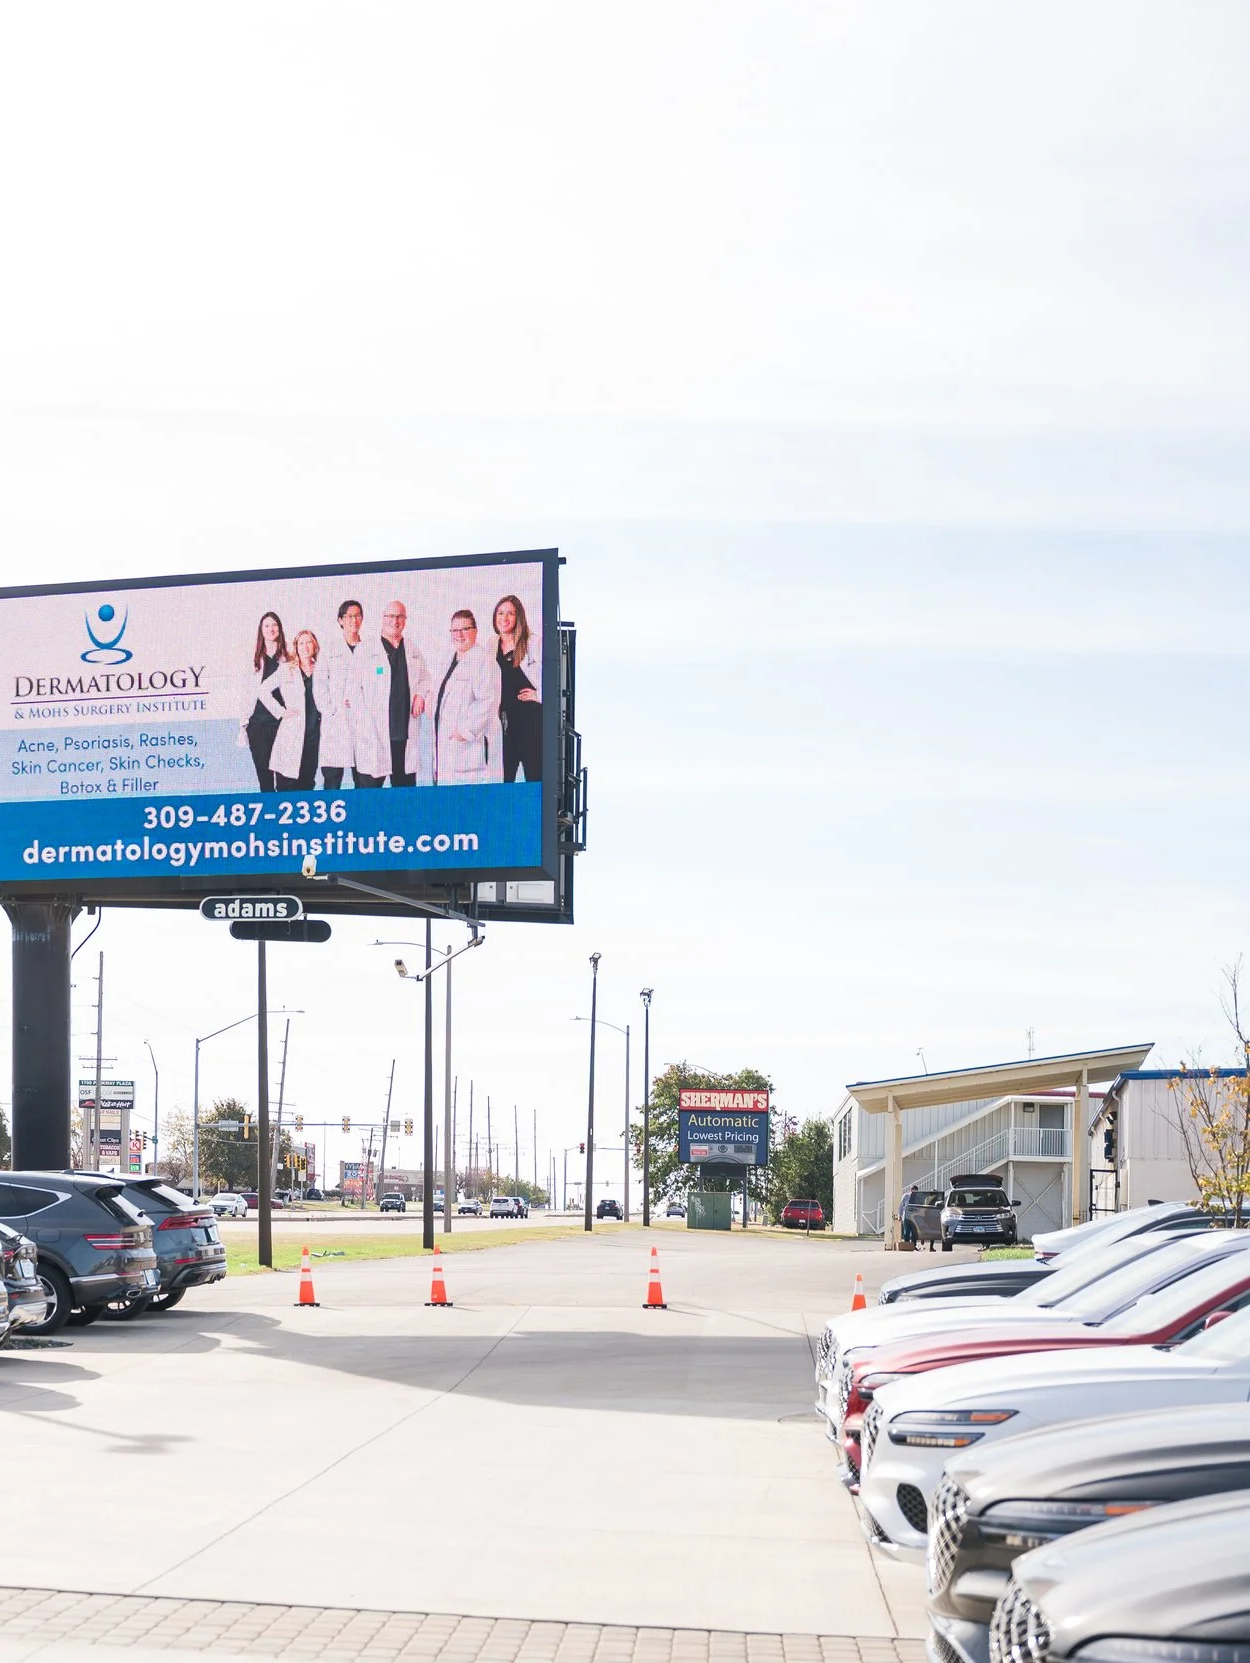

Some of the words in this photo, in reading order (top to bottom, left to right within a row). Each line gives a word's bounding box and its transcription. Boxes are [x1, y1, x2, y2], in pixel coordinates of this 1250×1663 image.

[14, 665, 207, 698] DERMATOLOGY
[14, 708, 25, 720] &
[28, 705, 70, 719] MOHS
[73, 702, 132, 717] SURGERY
[136, 699, 207, 714] INSTITUTE
[17, 739, 59, 755] Acne,
[64, 734, 134, 751] Psoriasis,
[139, 731, 198, 748] Rashes,
[11, 760, 42, 776] Skin
[46, 759, 105, 774] Cancer,
[109, 755, 141, 771] Skin
[145, 753, 206, 770] Checks,
[60, 780, 102, 795] Botox
[106, 778, 117, 793] &
[122, 777, 159, 792] Filler
[142, 799, 348, 829] 309-487-2336
[22, 830, 480, 867] dermatologymohsinstitute.com
[213, 899, 288, 918] adams
[680, 1092, 767, 1110] SHERMAN'S
[688, 1114, 759, 1128] Automatic
[687, 1131, 723, 1141] Lowest
[725, 1132, 759, 1143] Pricing
